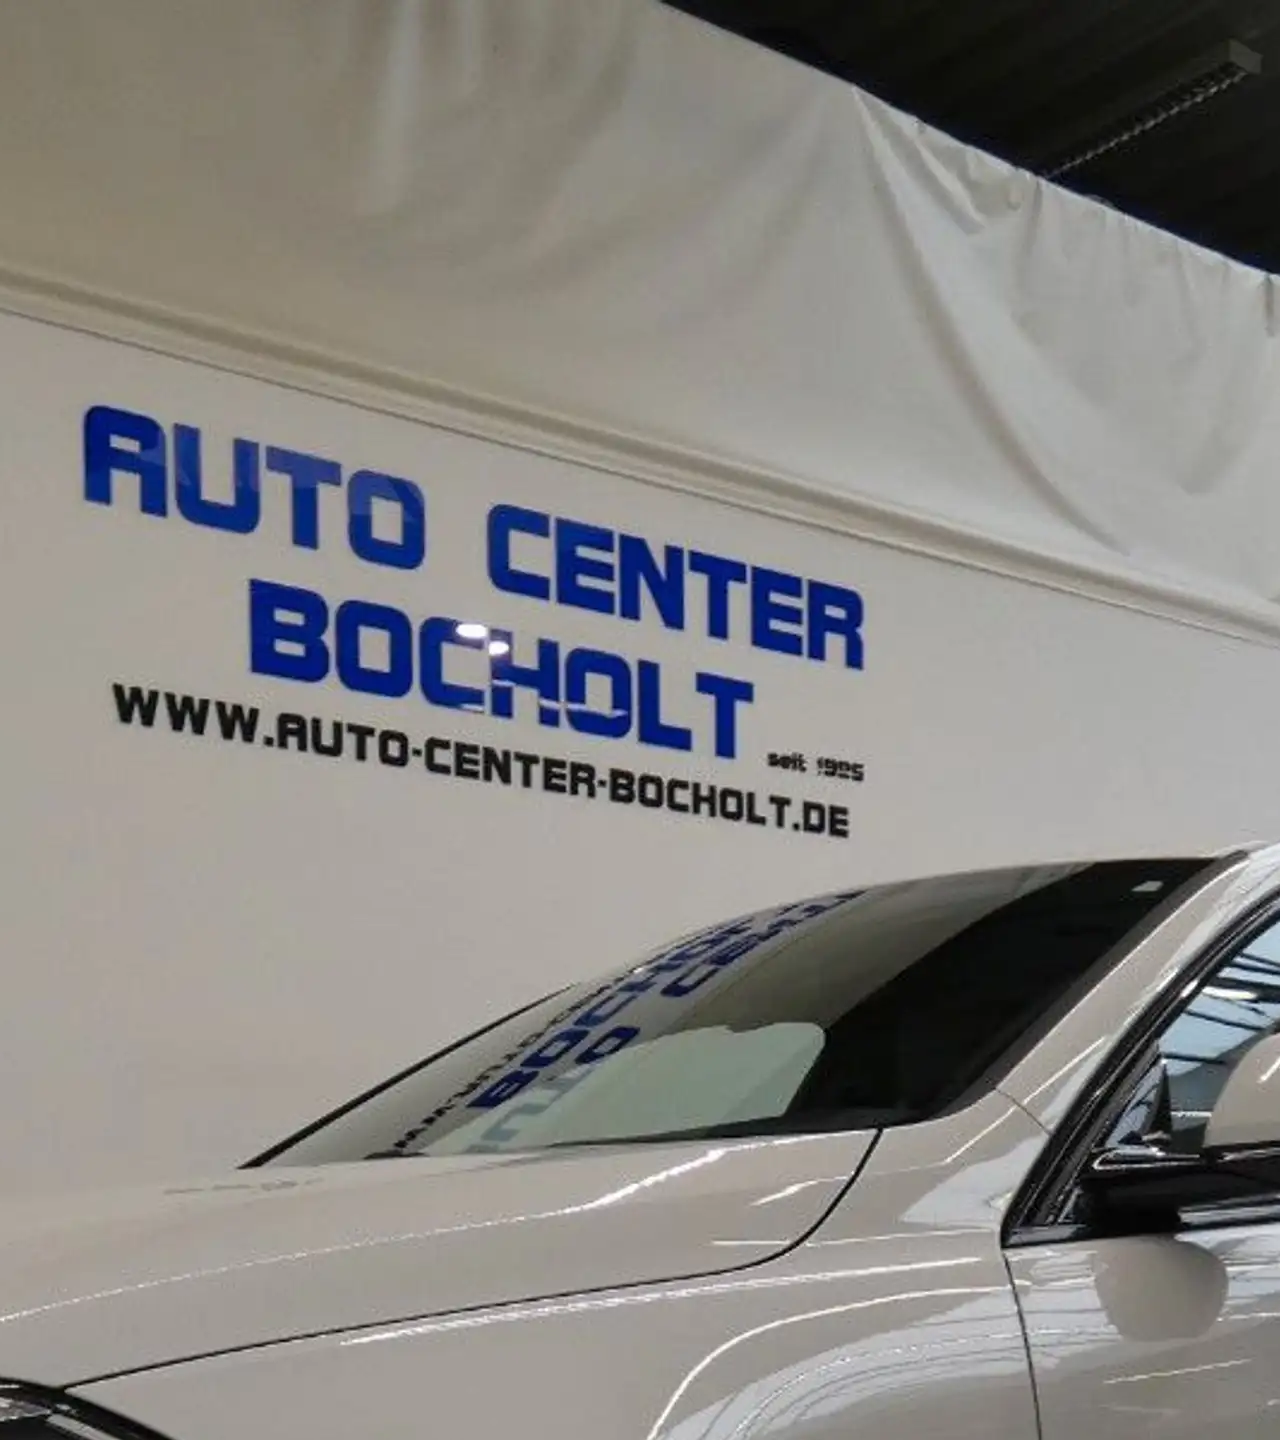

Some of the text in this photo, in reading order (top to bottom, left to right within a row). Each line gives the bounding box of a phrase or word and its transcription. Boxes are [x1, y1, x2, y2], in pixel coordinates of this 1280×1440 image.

[81, 403, 866, 672] AUTO CENTER
[247, 577, 756, 761] BOCHOLT
[110, 681, 850, 840] WWW.AUTO-CENTER-BOCHOLT.DE
[766, 751, 808, 774] seit
